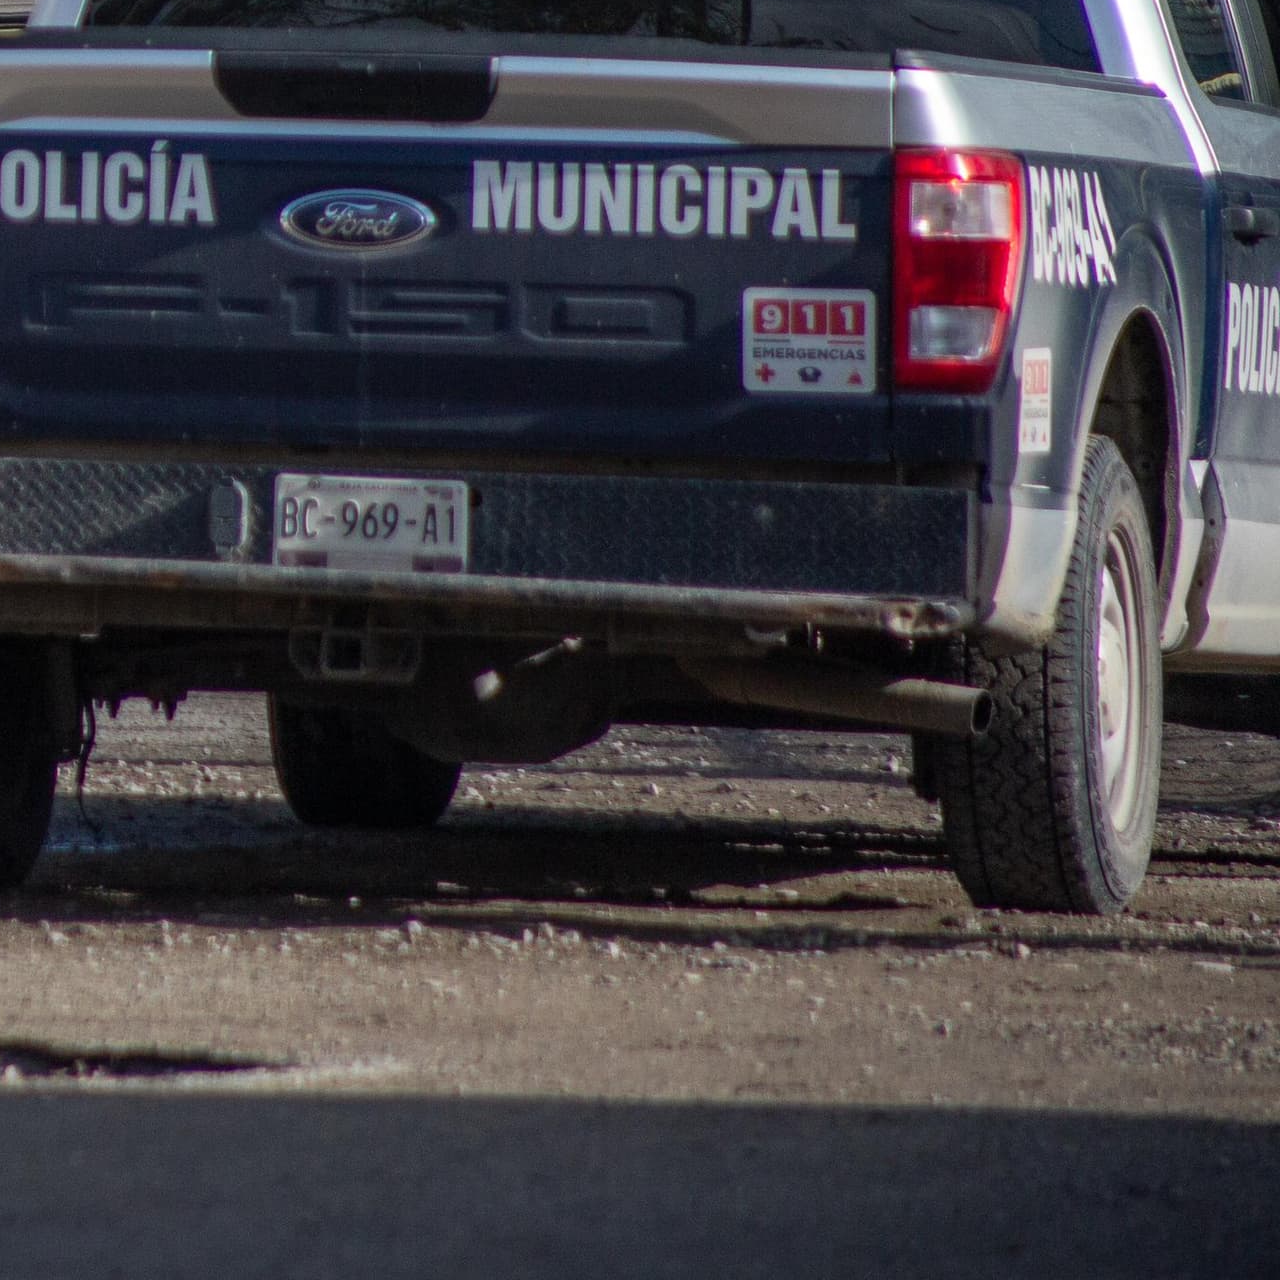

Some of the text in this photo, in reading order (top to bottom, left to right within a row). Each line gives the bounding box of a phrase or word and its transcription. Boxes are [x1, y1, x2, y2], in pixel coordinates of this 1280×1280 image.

[315, 201, 400, 237] Ford
[471, 159, 858, 241] MUNICIPAL
[23, 273, 697, 347] F-150
[760, 304, 856, 332] 911
[752, 347, 866, 360] EMERGENCIAS
[280, 496, 456, 545] BC-969-A1
